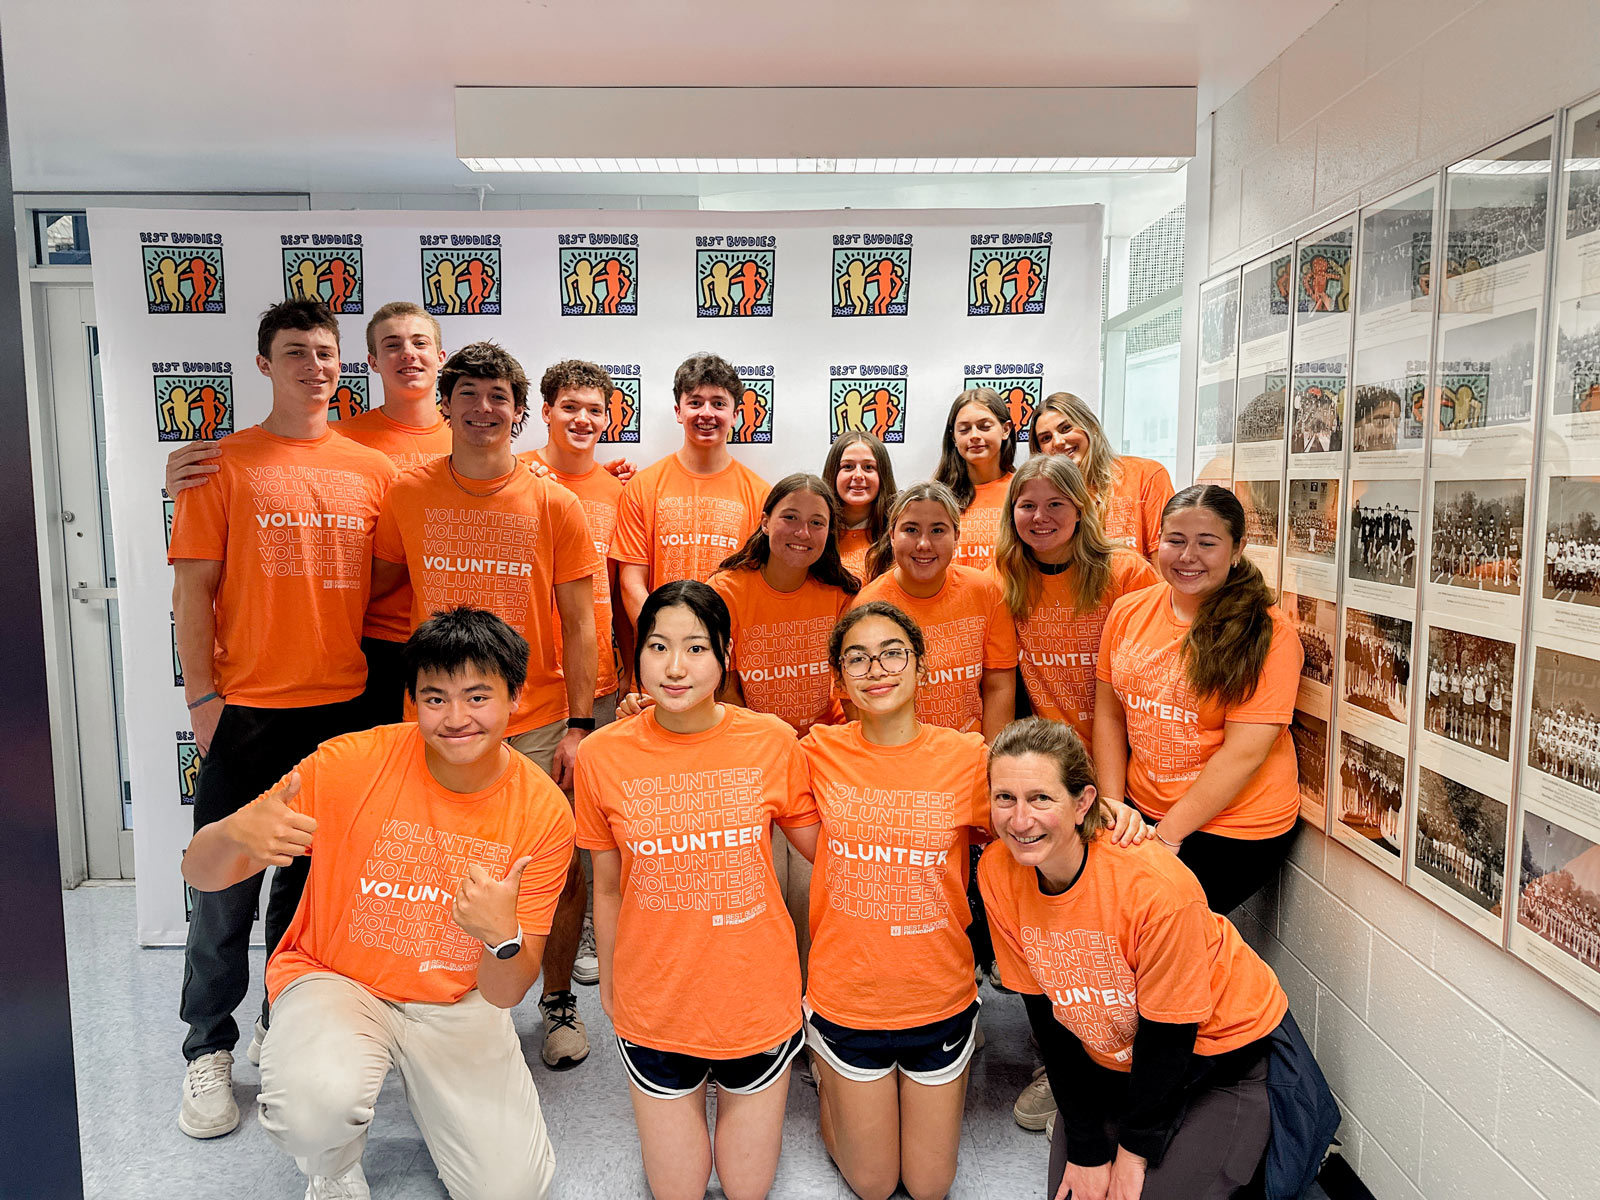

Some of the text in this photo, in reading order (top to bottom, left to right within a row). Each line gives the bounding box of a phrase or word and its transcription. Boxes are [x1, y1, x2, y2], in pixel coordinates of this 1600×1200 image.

[140, 232, 223, 245] BEST BUDDIES
[280, 234, 362, 245] BEST BUDDIES
[419, 234, 501, 245] BEST BUDDIES
[558, 233, 639, 245] BEST BUDDIES
[696, 235, 776, 246] BEST BUDDIES
[833, 234, 913, 246] BEST BUDDIES
[970, 232, 1052, 245] BEST BUDDIES
[152, 362, 232, 374] BEST BUDDIES
[734, 362, 774, 376] UDDIES
[830, 364, 907, 376] BEST BUDDIES
[964, 363, 1043, 375] BEST BUDDIES
[246, 465, 364, 485] VOLUNTEER
[250, 480, 366, 499] VOLUNTEER
[256, 512, 365, 531] VOLUNTEER
[425, 508, 540, 531] VOLUNTEER
[257, 528, 365, 547] VOLUNTEER
[424, 524, 538, 547] VOLUNTEER
[423, 540, 536, 562] VOLUNTEER
[423, 555, 533, 577] VOLUNTEER
[422, 571, 531, 592] VOLUNTEER
[423, 586, 529, 608] VOLUNTEER
[740, 646, 828, 668] VOLUNTEE
[740, 661, 829, 682] VOLUNTEE
[1112, 672, 1200, 711] OLUNTEER
[622, 767, 762, 797] VOLUNTEER
[623, 786, 764, 817] VOLUNTEER
[624, 805, 764, 838] VOLUNTEER
[382, 818, 512, 864] VOLUNTEER
[625, 825, 763, 856] VOLUNTEER
[632, 844, 765, 874] VOLUNTEER
[366, 859, 461, 895] VOLUNT
[629, 863, 766, 893] VOLUNTEER
[360, 878, 457, 906] VOLUNT
[634, 880, 765, 911] VOLUNTEER
[349, 924, 482, 961] VOLUNTEER
